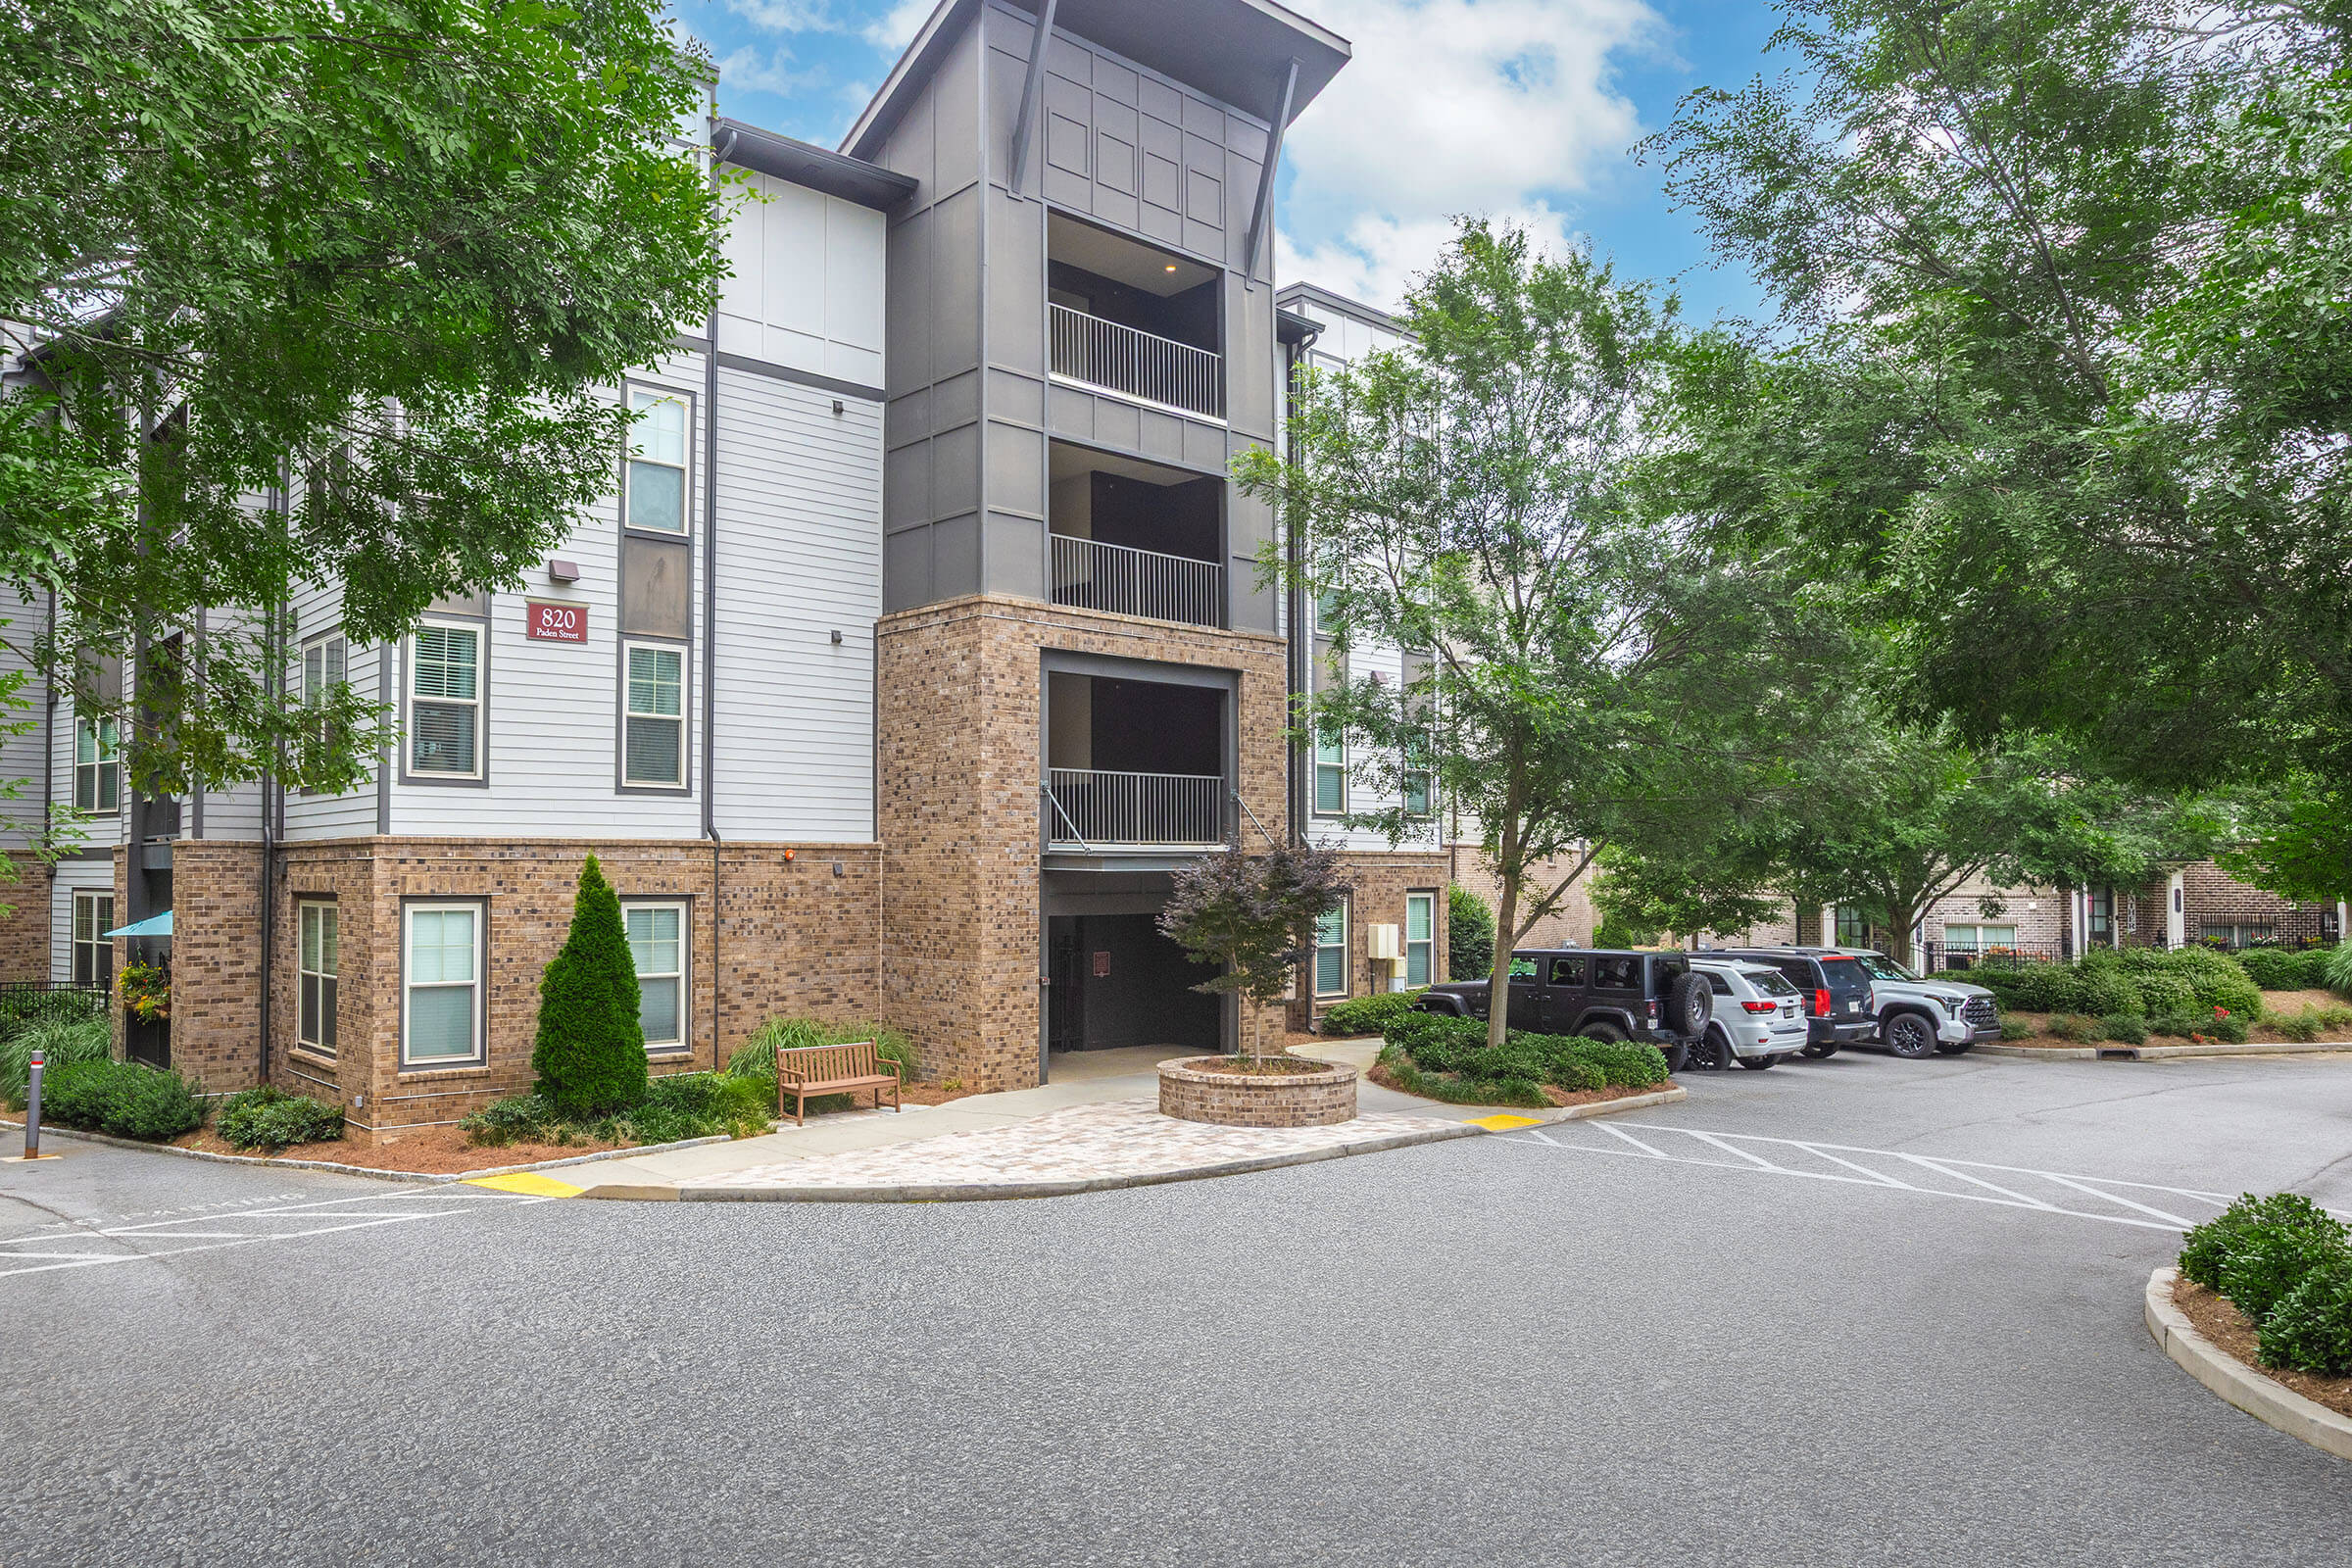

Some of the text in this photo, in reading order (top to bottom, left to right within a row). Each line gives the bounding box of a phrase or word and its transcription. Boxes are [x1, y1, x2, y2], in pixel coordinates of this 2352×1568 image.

[542, 609, 576, 628] 820
[536, 627, 579, 639] Paden Street
